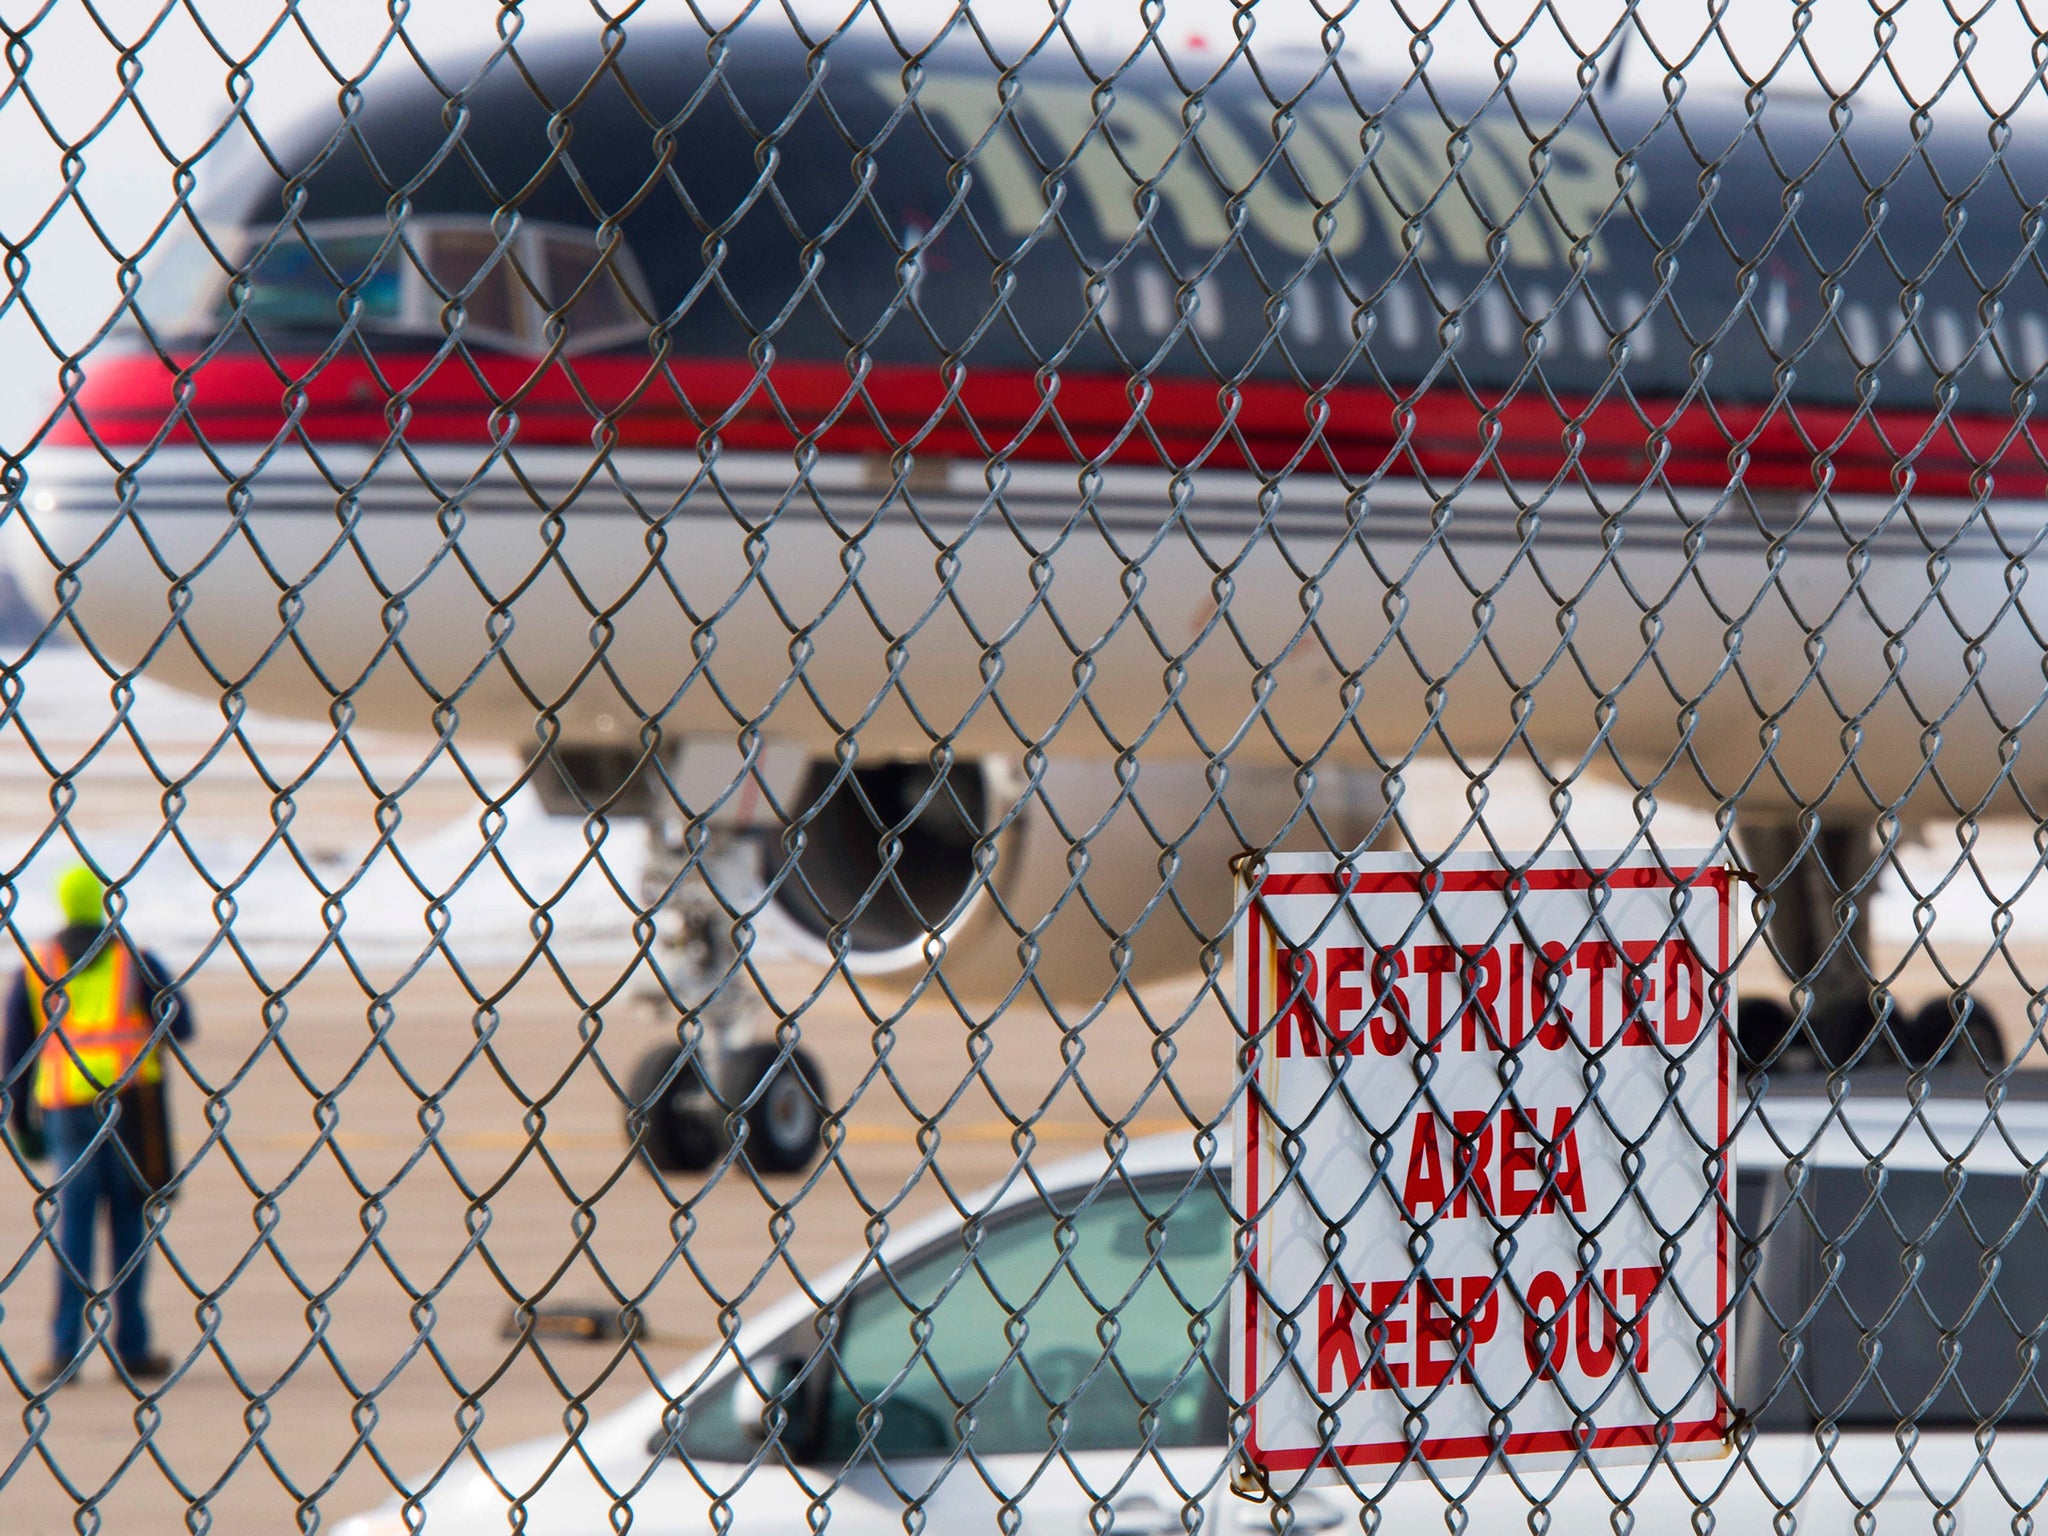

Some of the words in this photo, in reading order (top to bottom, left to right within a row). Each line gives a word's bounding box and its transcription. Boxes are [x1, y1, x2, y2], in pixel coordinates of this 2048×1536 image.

[870, 72, 1648, 270] TRUMP
[1276, 940, 1703, 1058] RESTRICTED
[1401, 1106, 1587, 1221] AREA
[1317, 1275, 1498, 1394] KEEP
[1523, 1266, 1664, 1381] OUT
